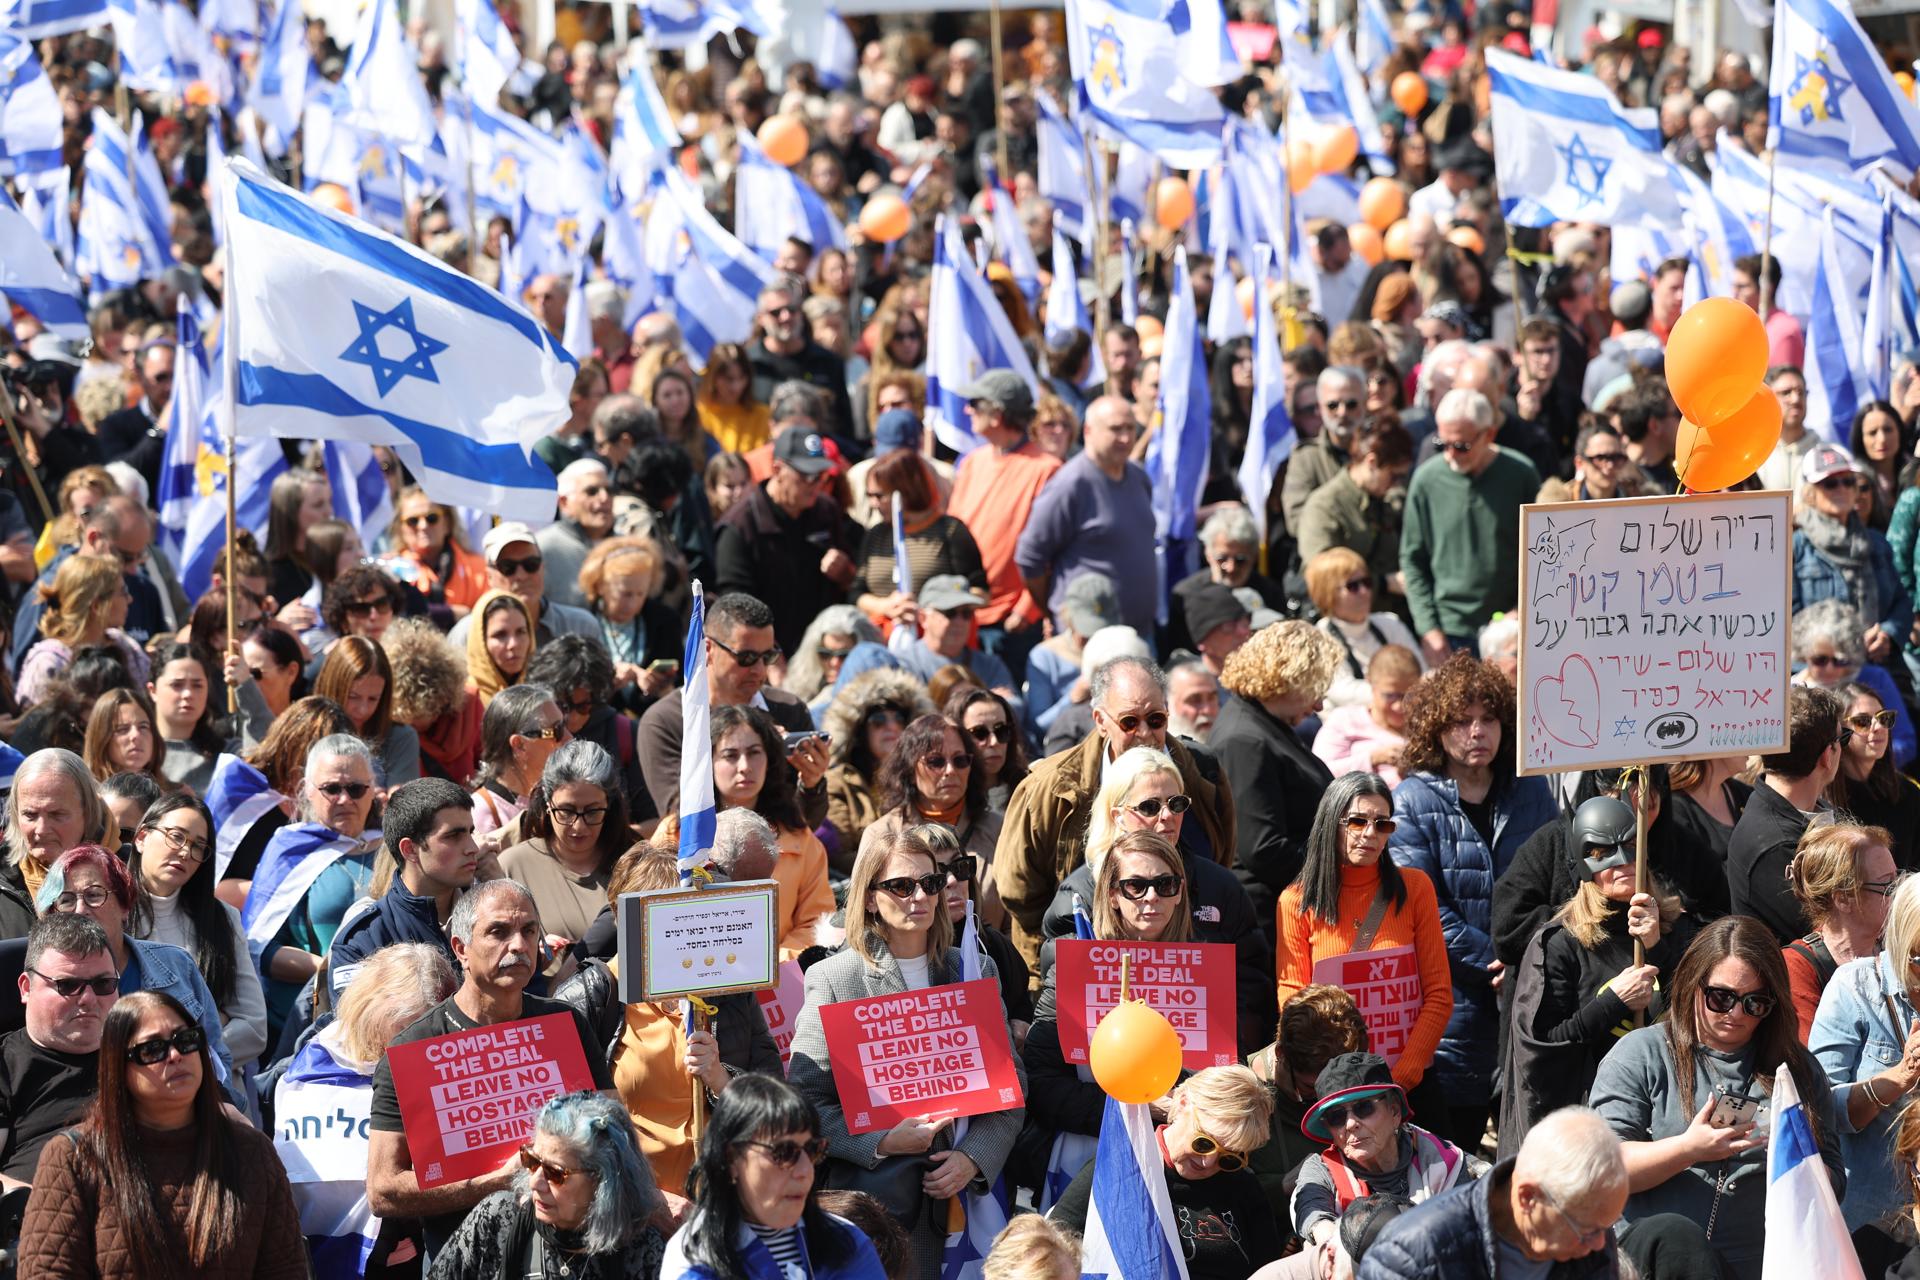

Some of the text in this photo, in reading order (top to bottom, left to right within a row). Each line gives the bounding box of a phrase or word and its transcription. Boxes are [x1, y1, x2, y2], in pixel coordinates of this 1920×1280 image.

[1620, 506, 1703, 556] שלום
[1568, 561, 1741, 617] בטמן קטן
[1535, 612, 1567, 650] על
[1576, 613, 1629, 640] גיבור
[1710, 612, 1775, 639] עכשיו
[1746, 651, 1776, 673] היו
[1621, 678, 1773, 709] אריאל כפיר
[665, 922, 753, 938] האמנם עוד יבואו ימים
[713, 935, 743, 948] בסליחה
[1089, 946, 1202, 965] COMPLETE
[1368, 957, 1400, 981] לא
[1143, 967, 1194, 983] DEAL
[854, 989, 967, 1022] COMPLETE
[1166, 989, 1197, 1005] NO
[861, 1009, 963, 1040] THE DEAL
[425, 1023, 545, 1062] COMPLETE
[869, 1030, 969, 1061] LEAVE NO
[433, 1046, 543, 1081] THE DEAL
[873, 1053, 975, 1084] HOSTAGE
[443, 1066, 551, 1104] LEAVE NO
[887, 1075, 968, 1102] BEHIND
[464, 1116, 536, 1149] BEHIN
